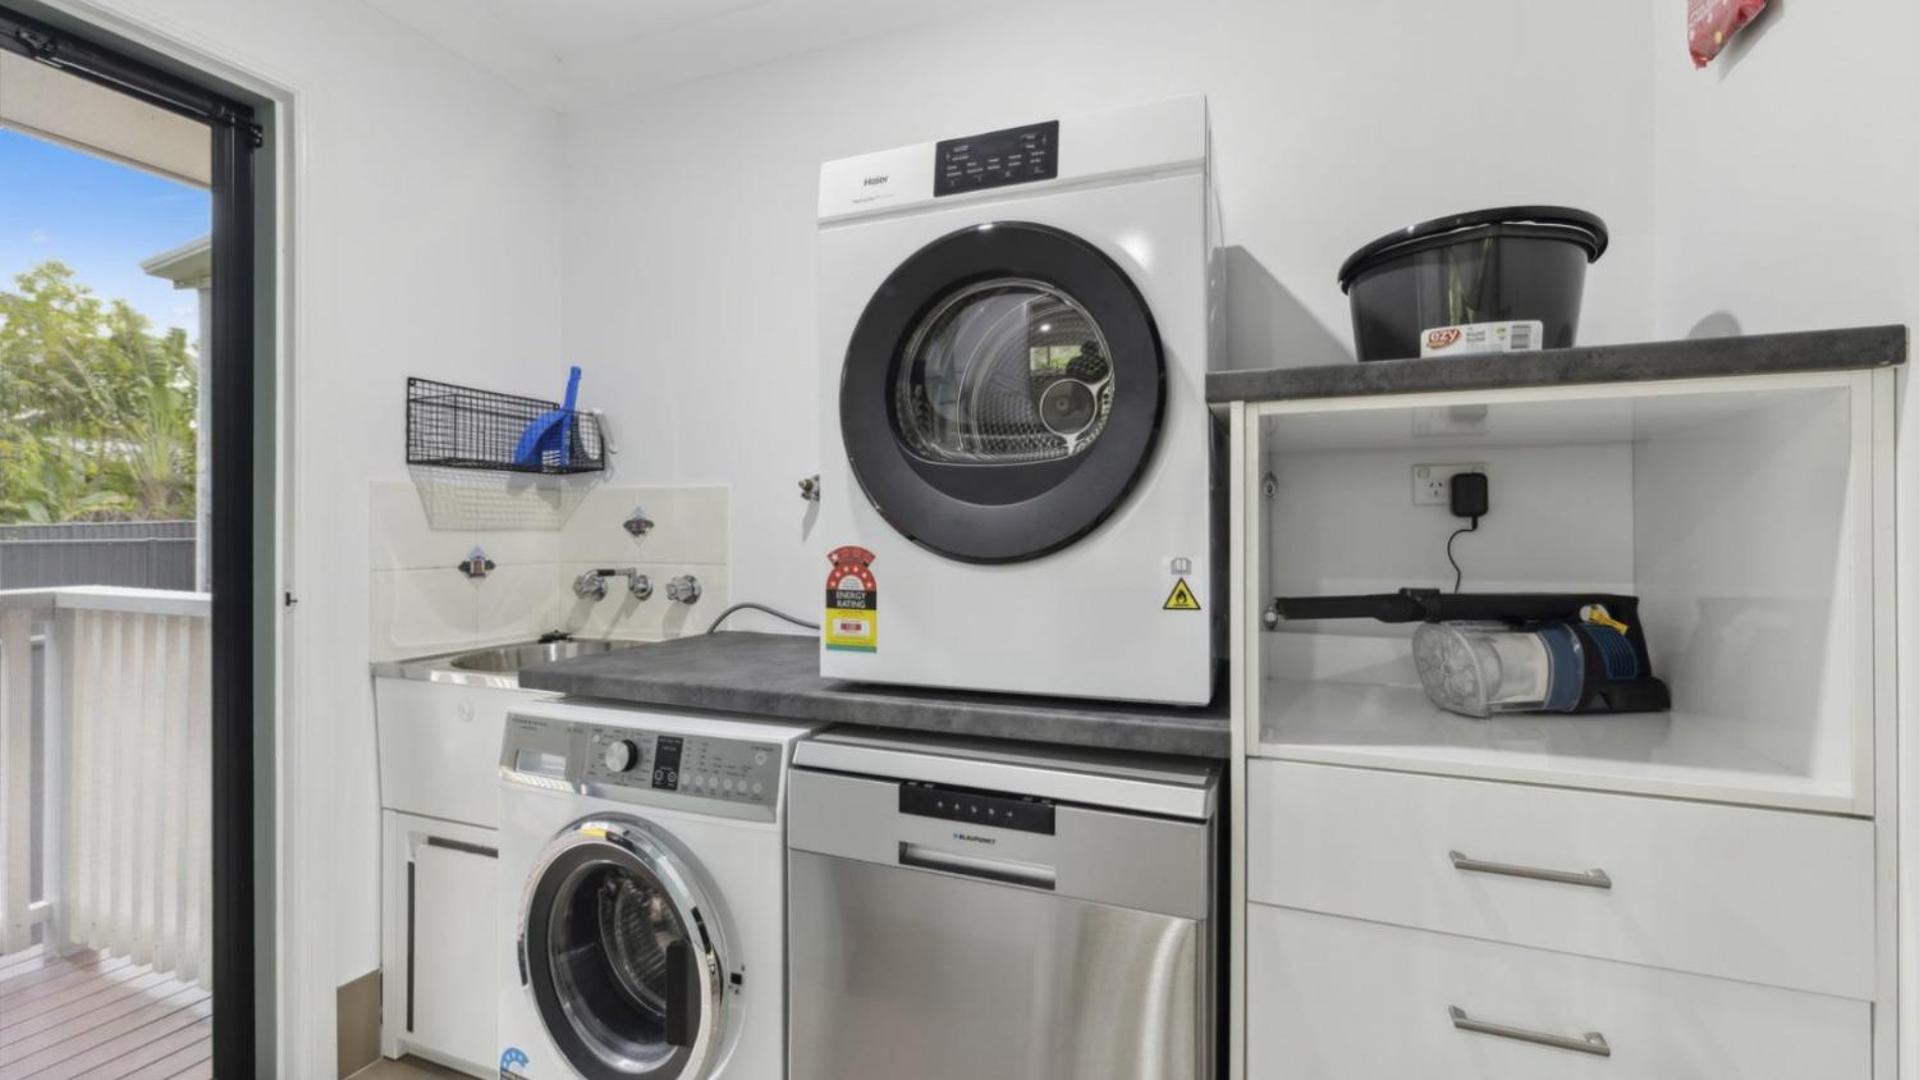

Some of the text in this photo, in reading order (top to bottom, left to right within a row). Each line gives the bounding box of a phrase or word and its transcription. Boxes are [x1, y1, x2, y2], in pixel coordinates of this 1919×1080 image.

[863, 175, 889, 187] Haier
[836, 591, 866, 600] ENERGY
[836, 600, 866, 609] RATING
[959, 833, 996, 844] BLAUPUNKT
